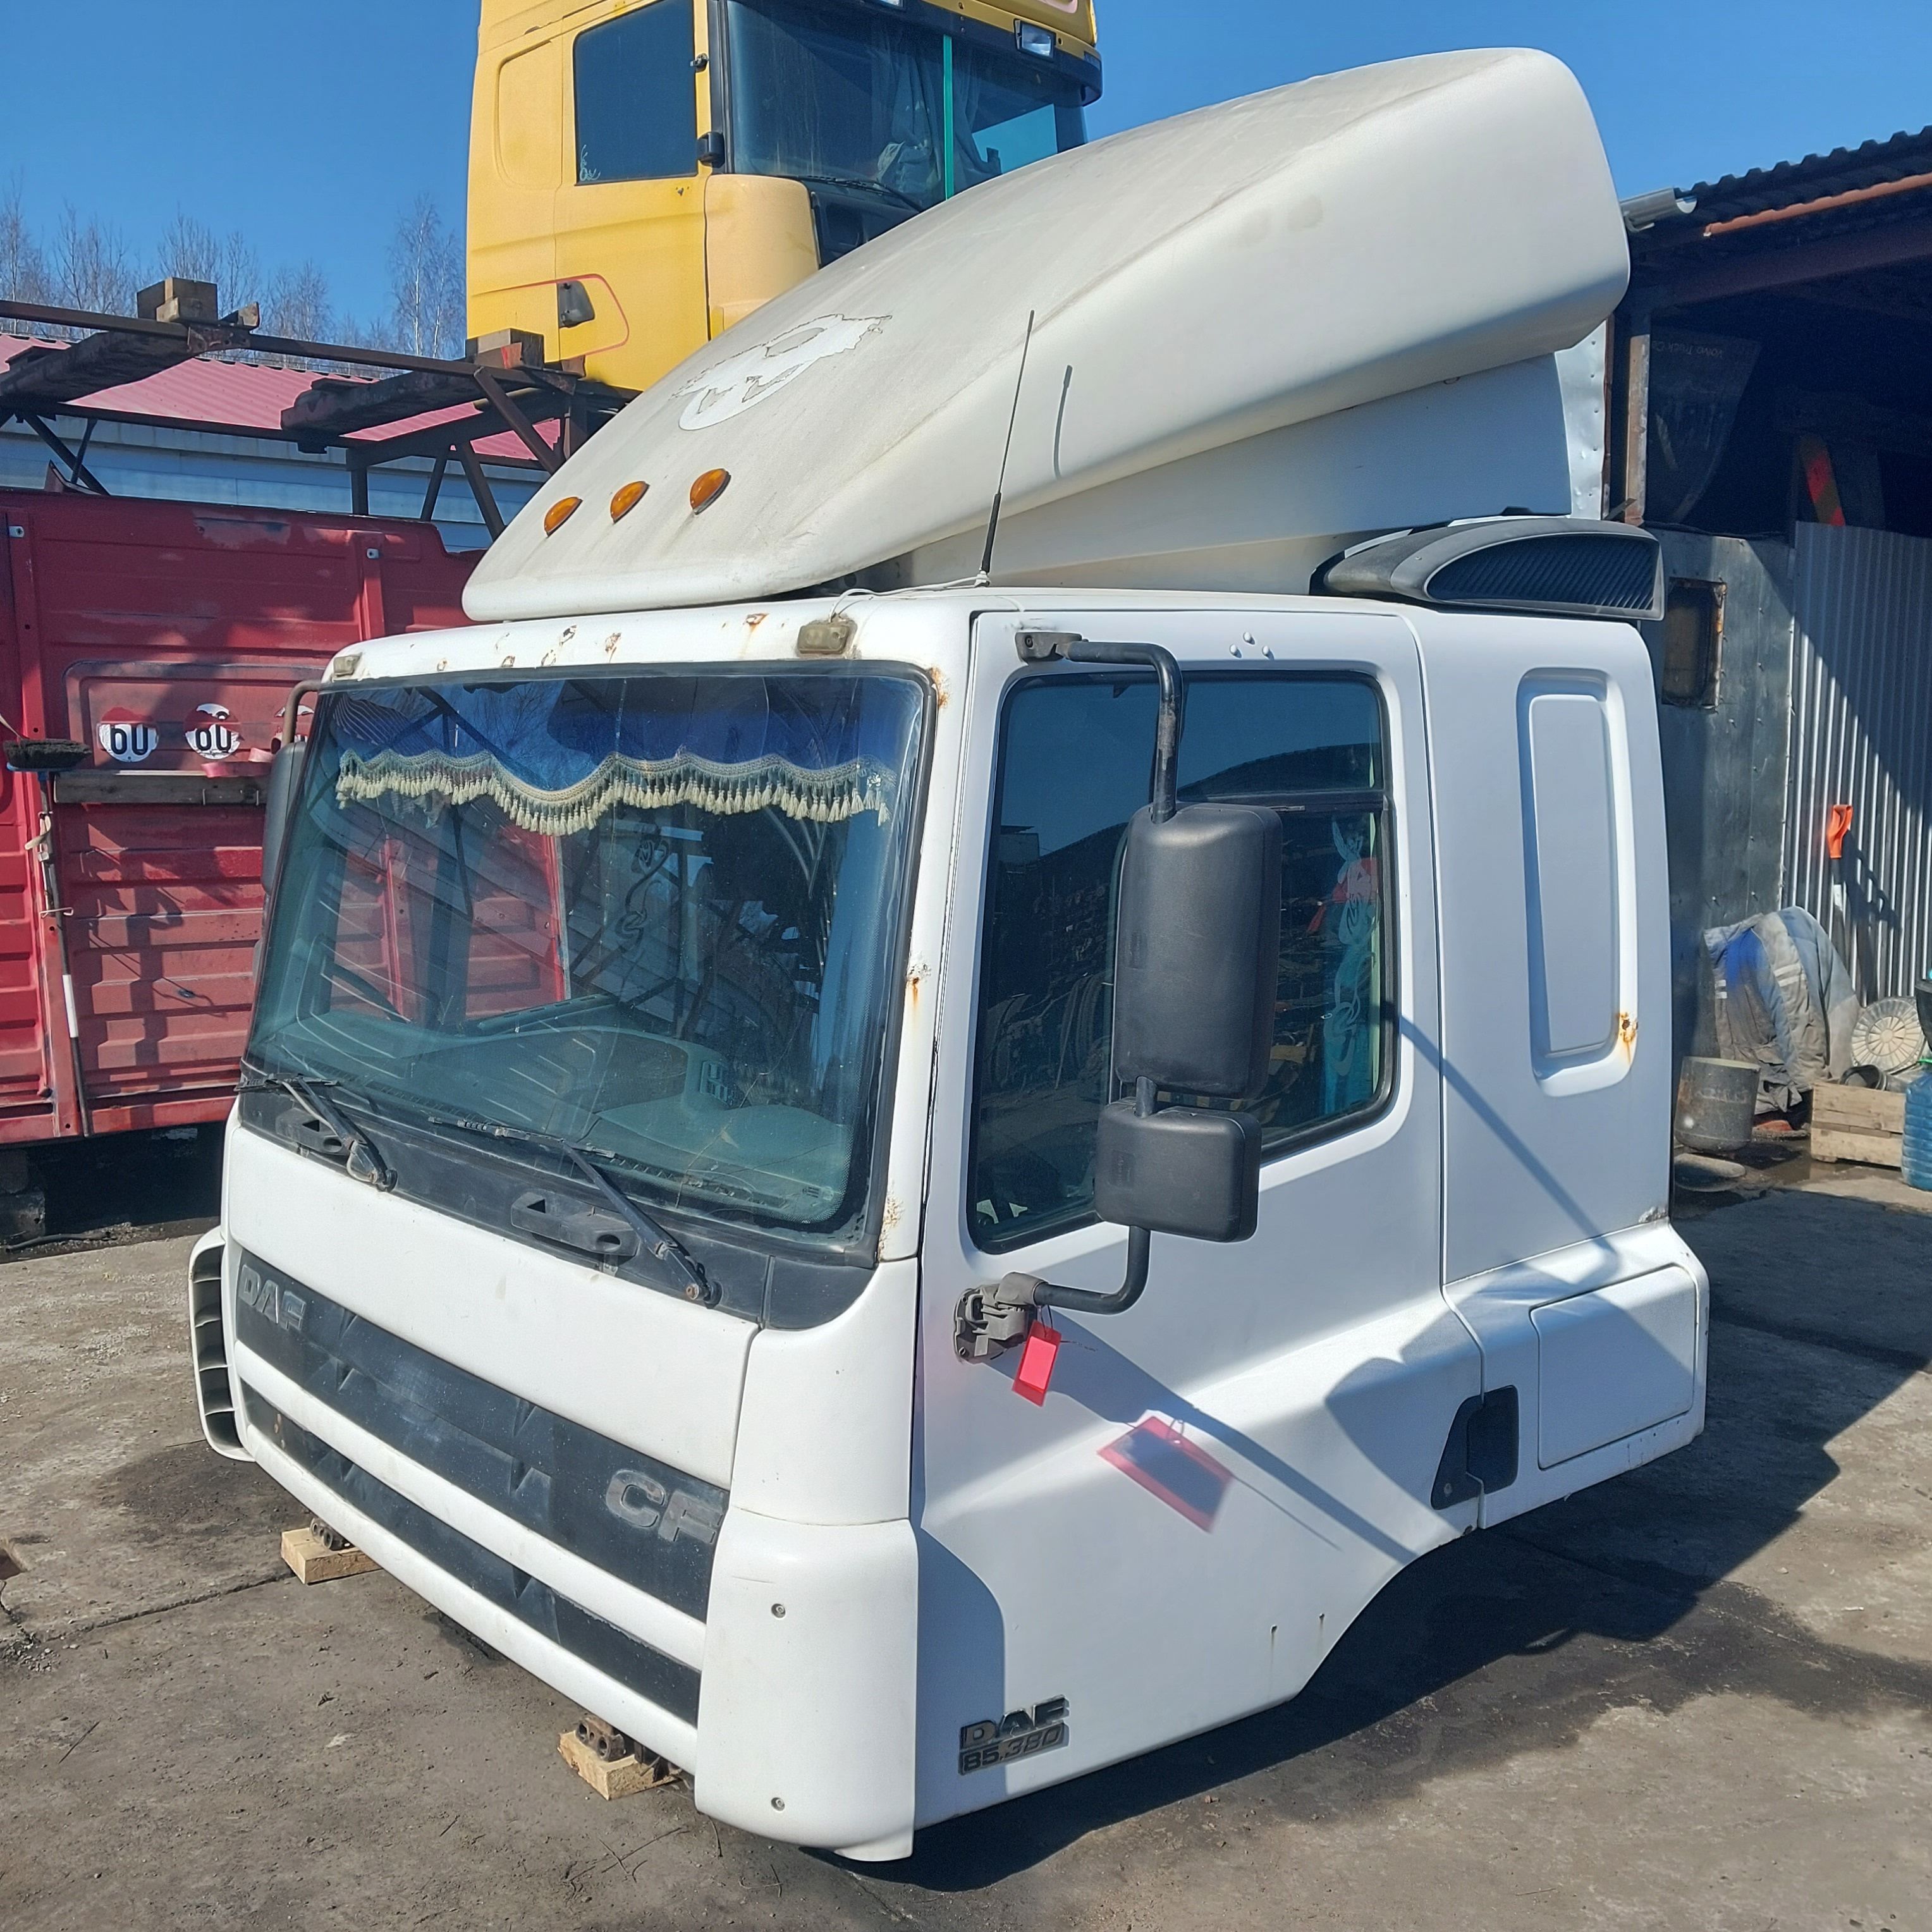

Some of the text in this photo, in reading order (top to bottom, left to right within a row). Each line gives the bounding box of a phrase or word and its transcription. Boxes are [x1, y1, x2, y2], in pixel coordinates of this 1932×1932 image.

[238, 1264, 306, 1331] DAF
[606, 1469, 724, 1544] CF
[959, 1694, 1070, 1749] DAF
[961, 1724, 1066, 1773] 85.380
